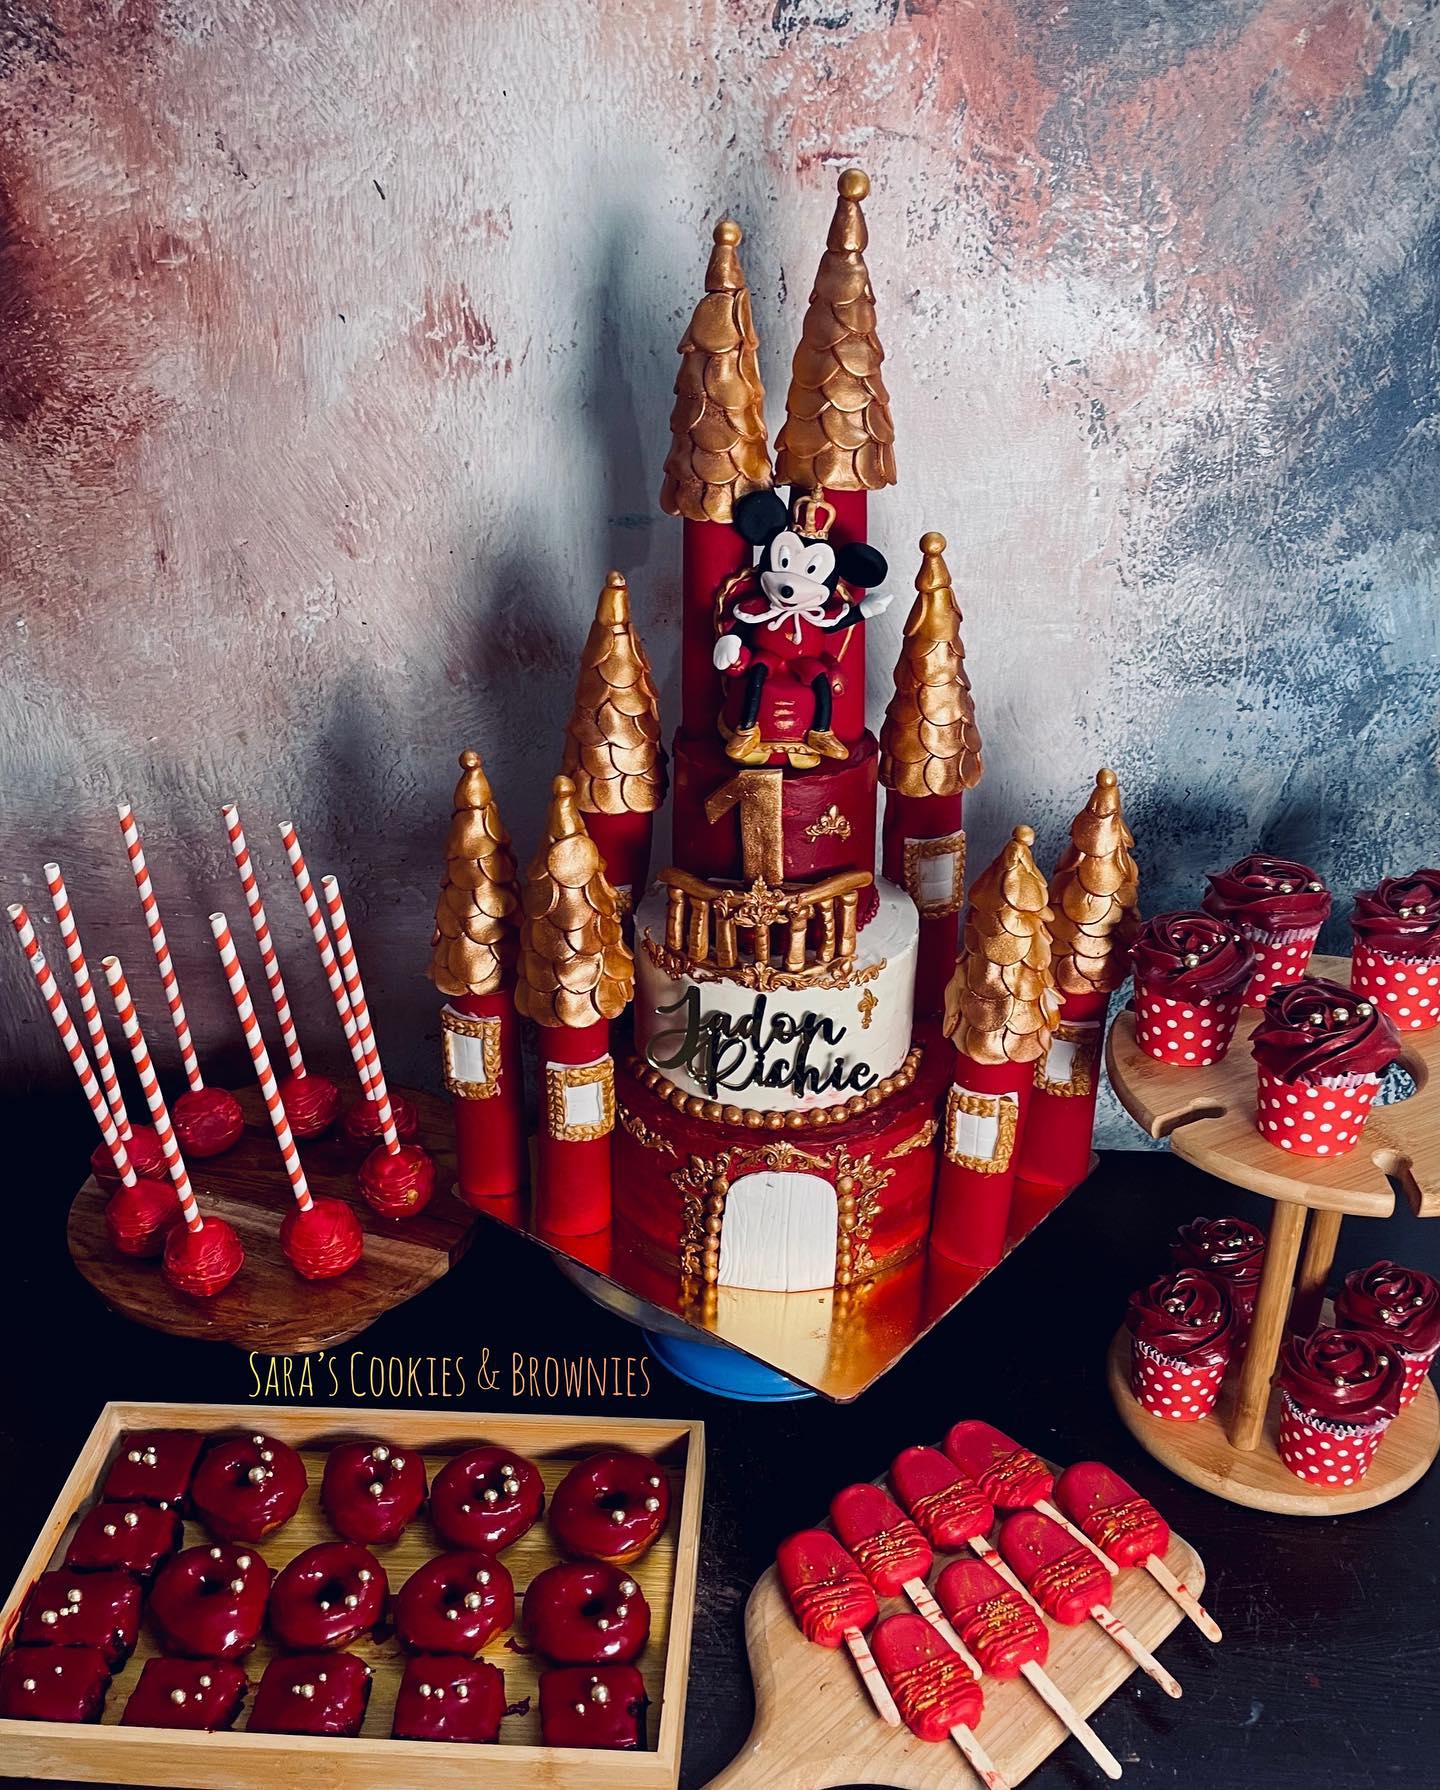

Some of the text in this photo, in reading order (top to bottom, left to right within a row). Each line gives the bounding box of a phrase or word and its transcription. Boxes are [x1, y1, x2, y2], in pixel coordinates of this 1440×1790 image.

[704, 769, 784, 886] 1
[646, 985, 847, 1069] Jadon
[687, 1030, 879, 1100] Richie
